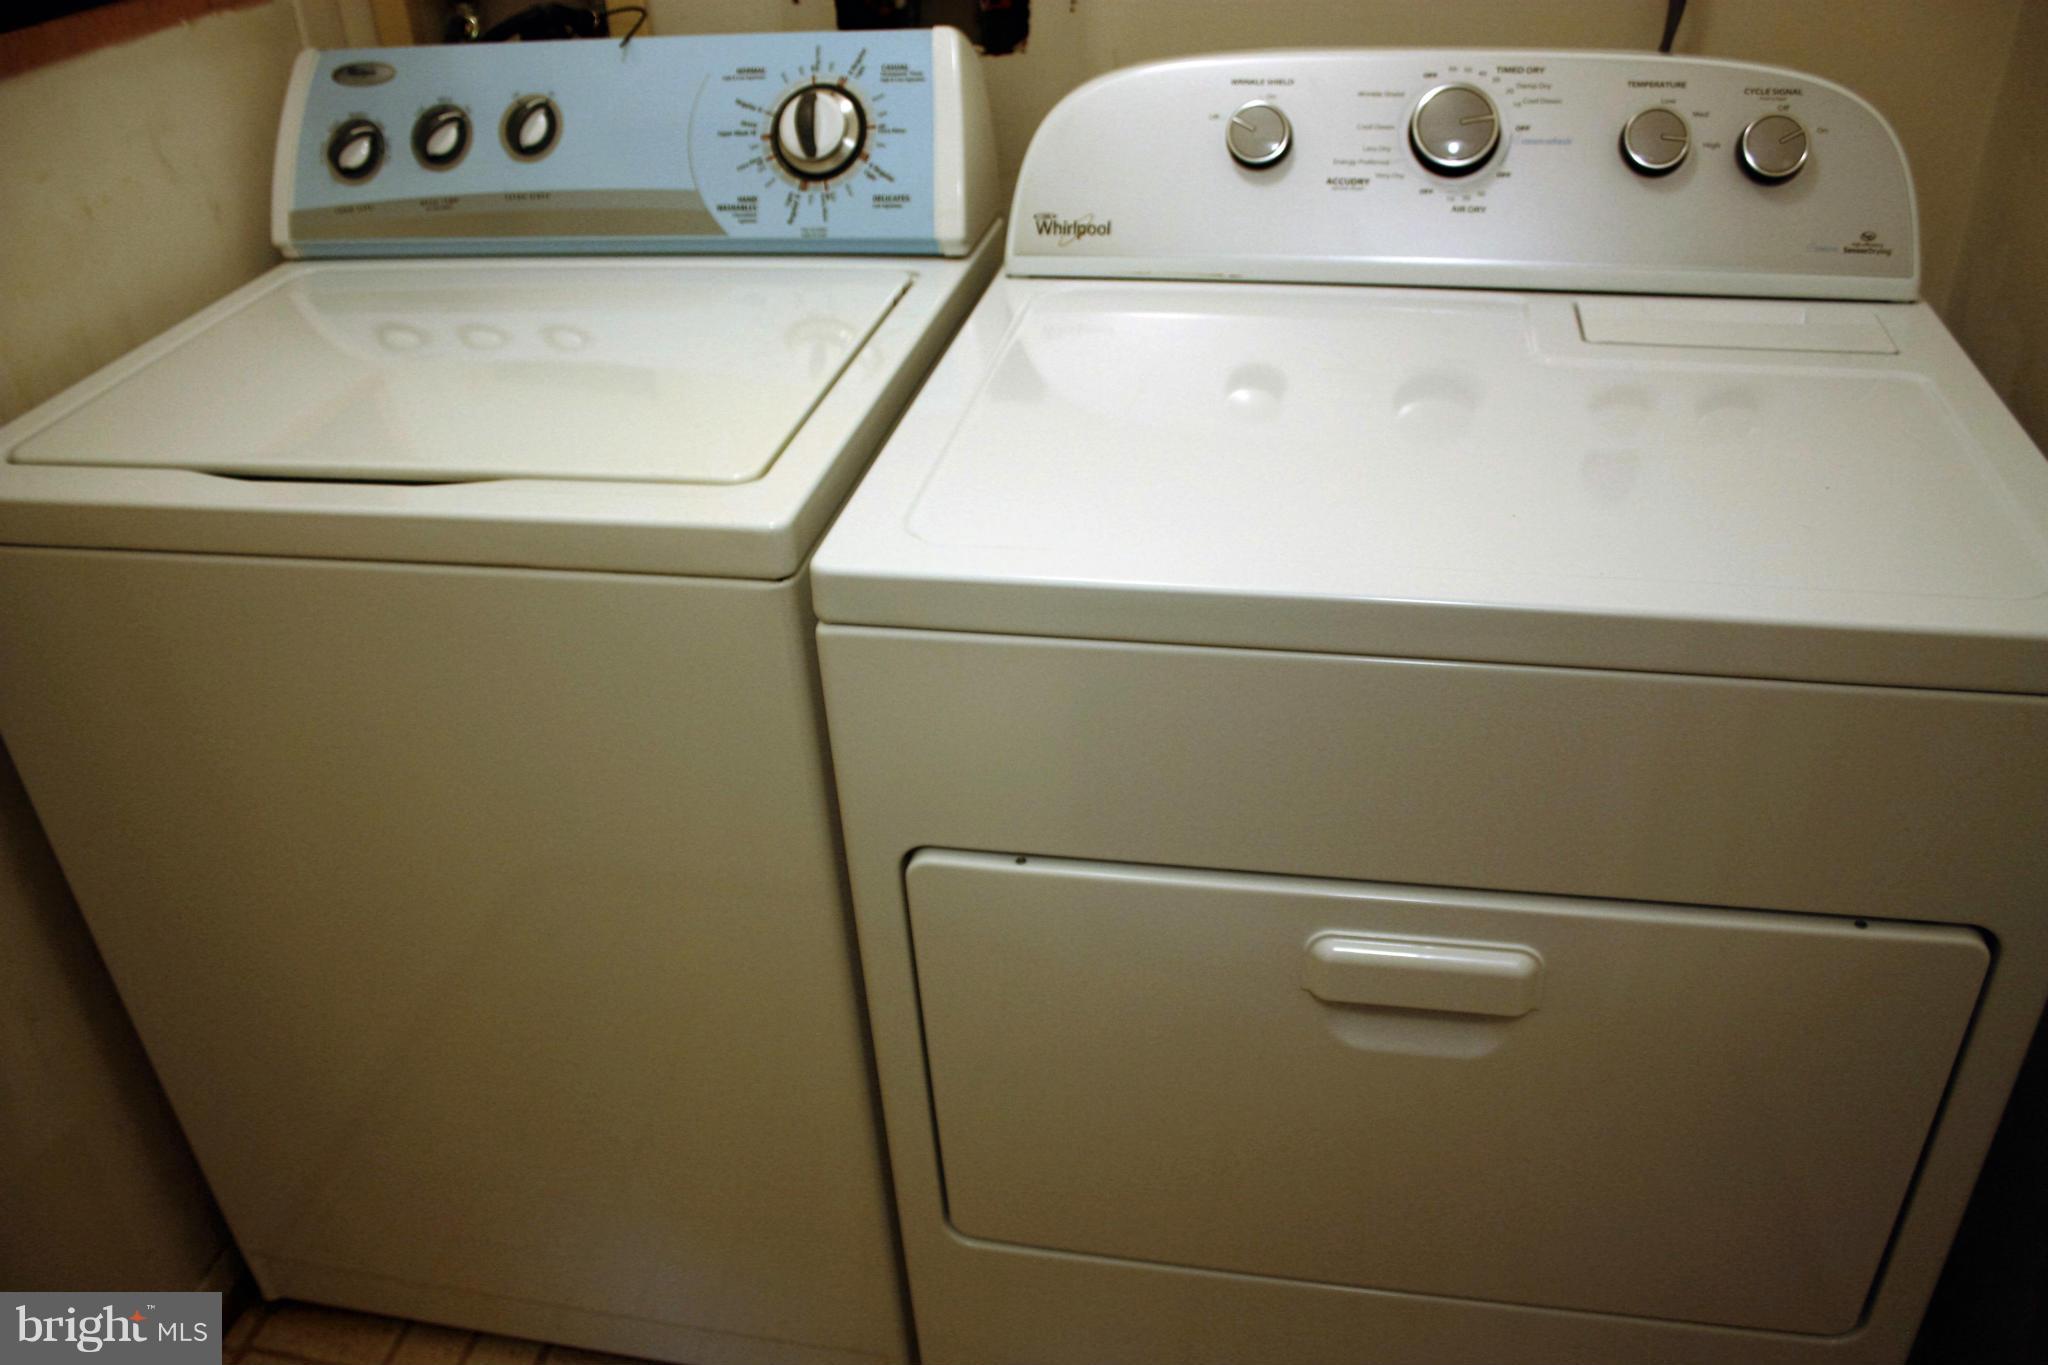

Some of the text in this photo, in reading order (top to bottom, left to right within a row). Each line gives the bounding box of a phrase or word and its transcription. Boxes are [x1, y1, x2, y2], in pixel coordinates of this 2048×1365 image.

[1627, 80, 1688, 88] TEMPERATURE
[1743, 87, 1804, 96] CYCLE SIGNAL
[1326, 176, 1371, 185] ACCUDRY
[1034, 218, 1112, 241] Whirlpool
